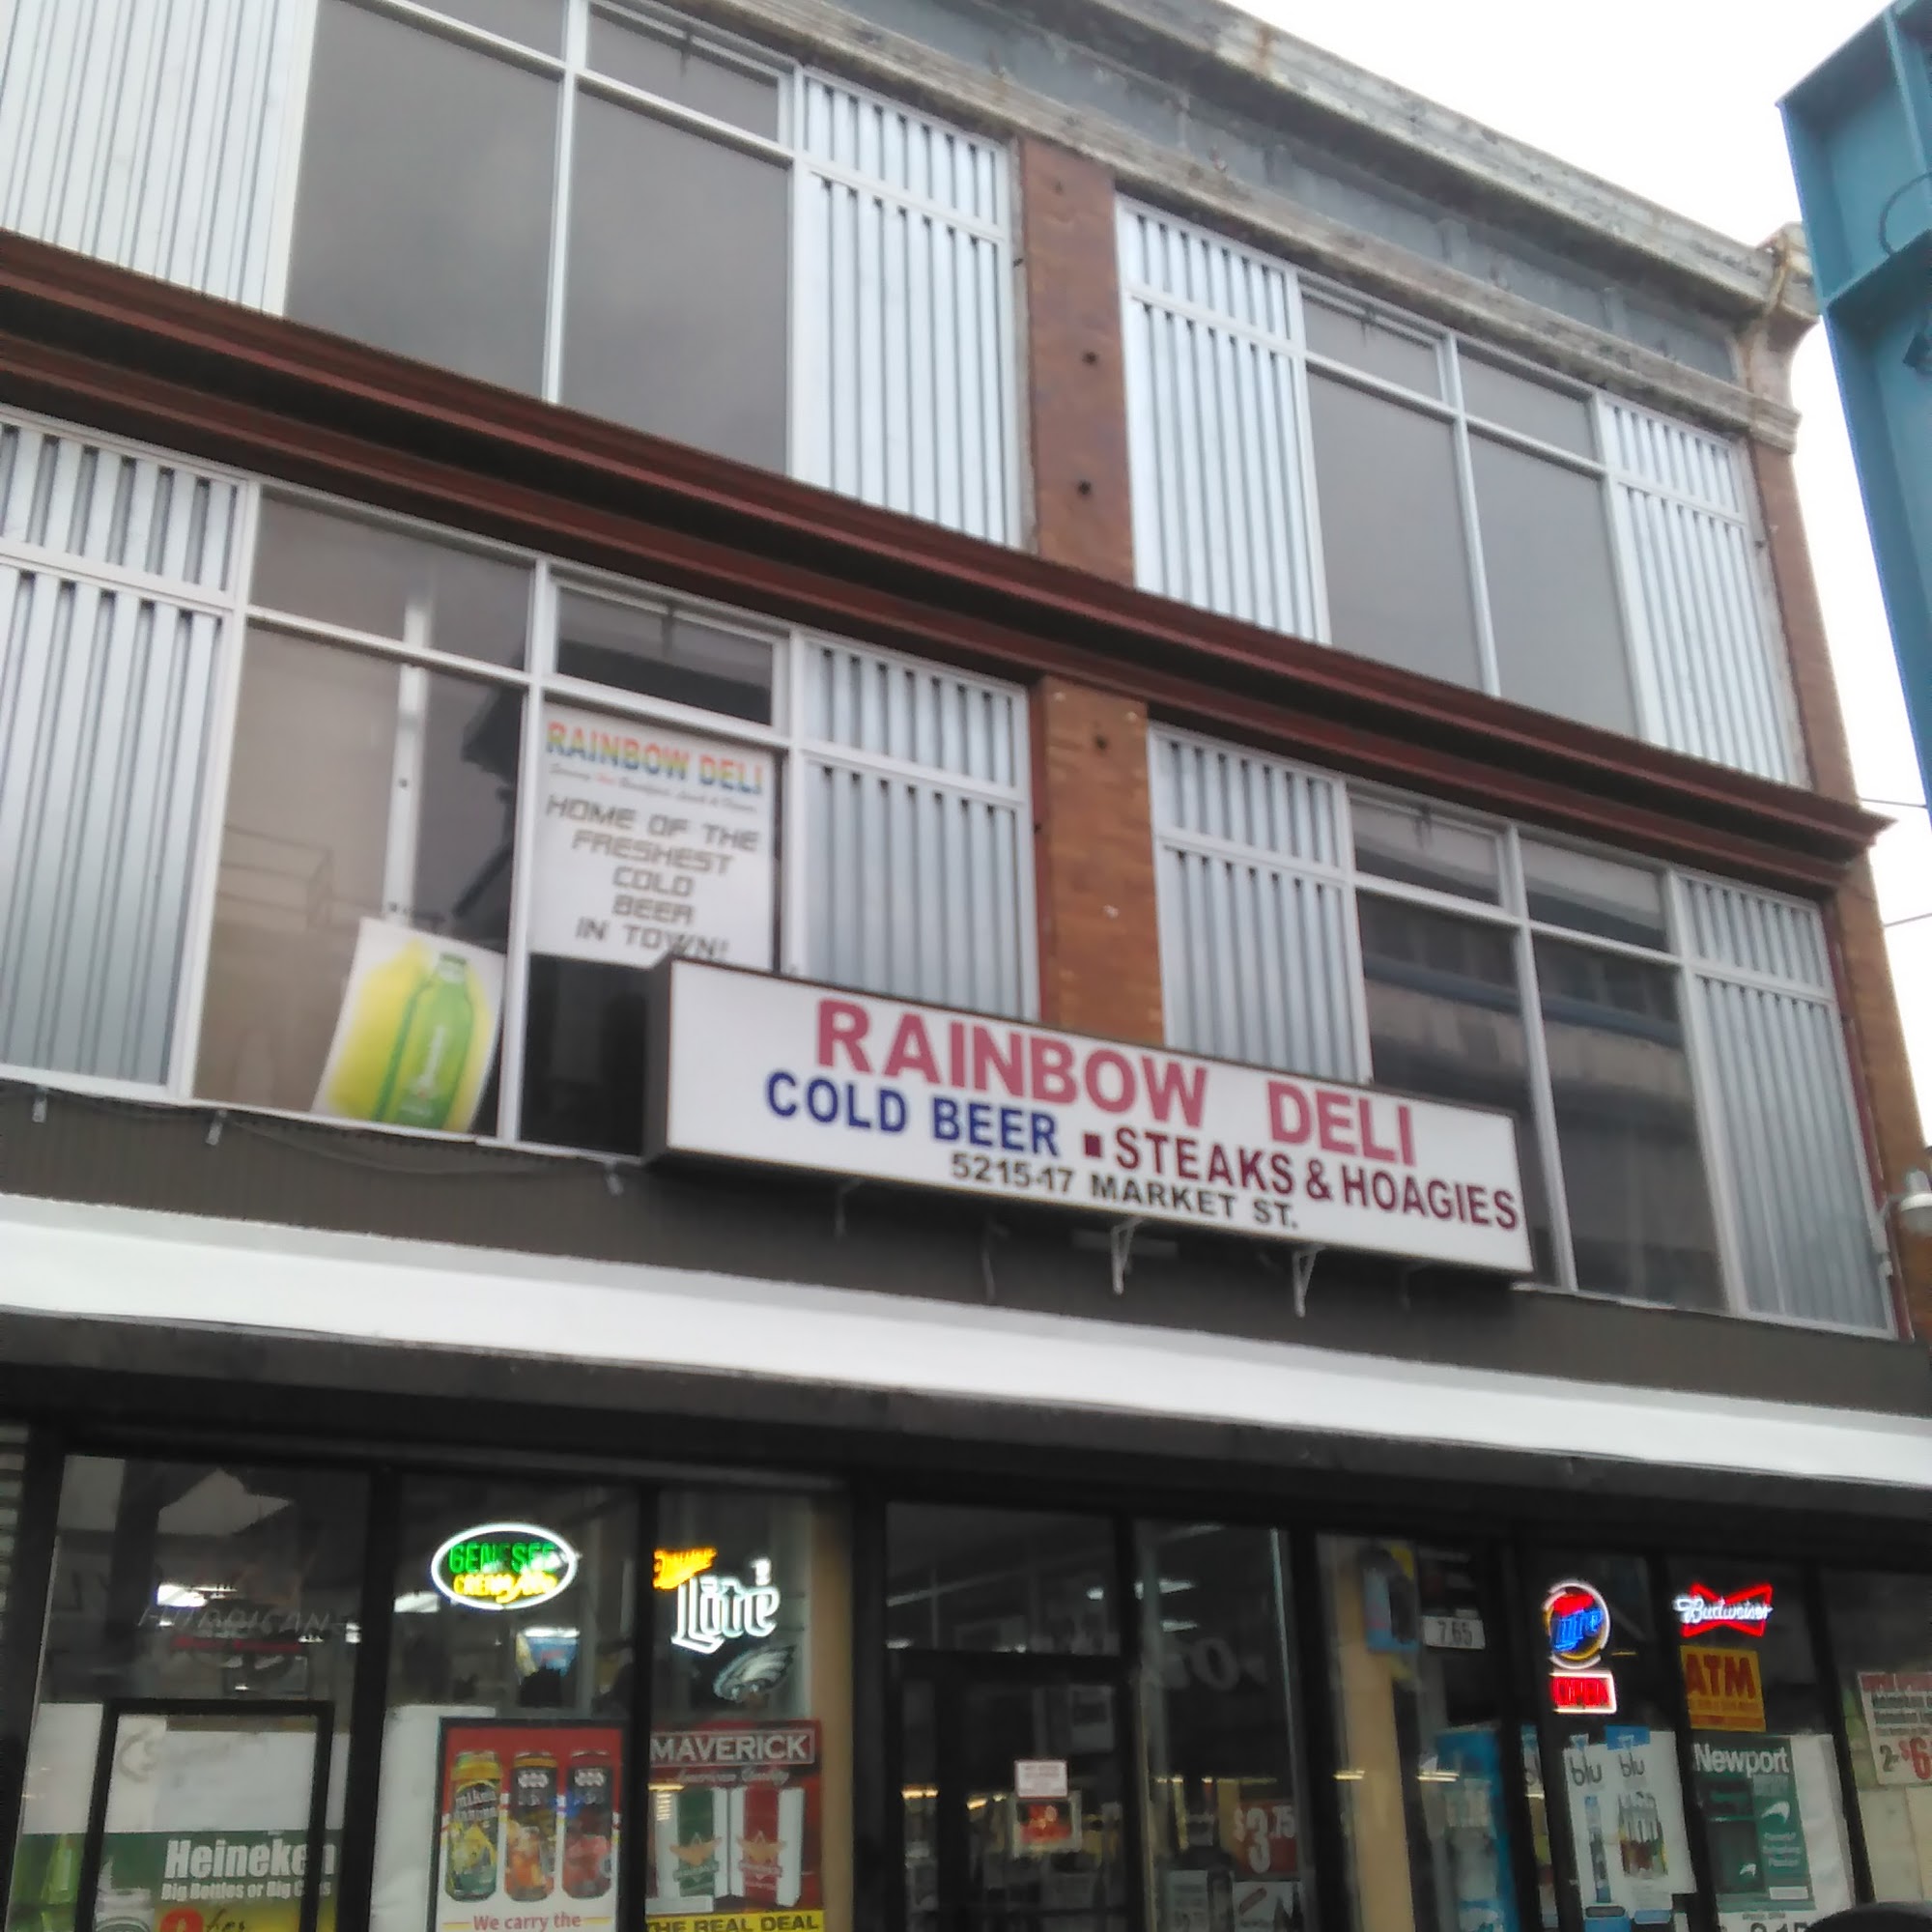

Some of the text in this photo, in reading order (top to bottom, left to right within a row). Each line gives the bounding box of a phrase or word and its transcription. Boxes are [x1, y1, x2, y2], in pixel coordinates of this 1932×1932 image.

[546, 721, 691, 781] RAINBOW
[698, 753, 763, 794] DELI
[546, 795, 759, 851] HOME OF THE
[571, 829, 734, 874] FRESHEST
[611, 866, 695, 897] COLD
[611, 894, 694, 924] BEER
[576, 916, 610, 941] IN
[816, 997, 1417, 1167] RAINBOW DELI
[767, 1072, 1520, 1232] COLD BEER STEAKS & HOAGIES
[952, 1151, 1299, 1231] 5215-17 MARKET ST.
[1672, 1592, 1774, 1624] Budweiser
[1685, 1653, 1756, 1700] ATM
[650, 1733, 809, 1761] MAVERICK
[1619, 1751, 1646, 1778] blu
[1693, 1743, 1790, 1778] Newport
[1570, 1749, 1603, 1786] blu
[473, 1912, 582, 1932] We carry the
[694, 1918, 753, 1932] REAL
[761, 1916, 819, 1931] DEAL
